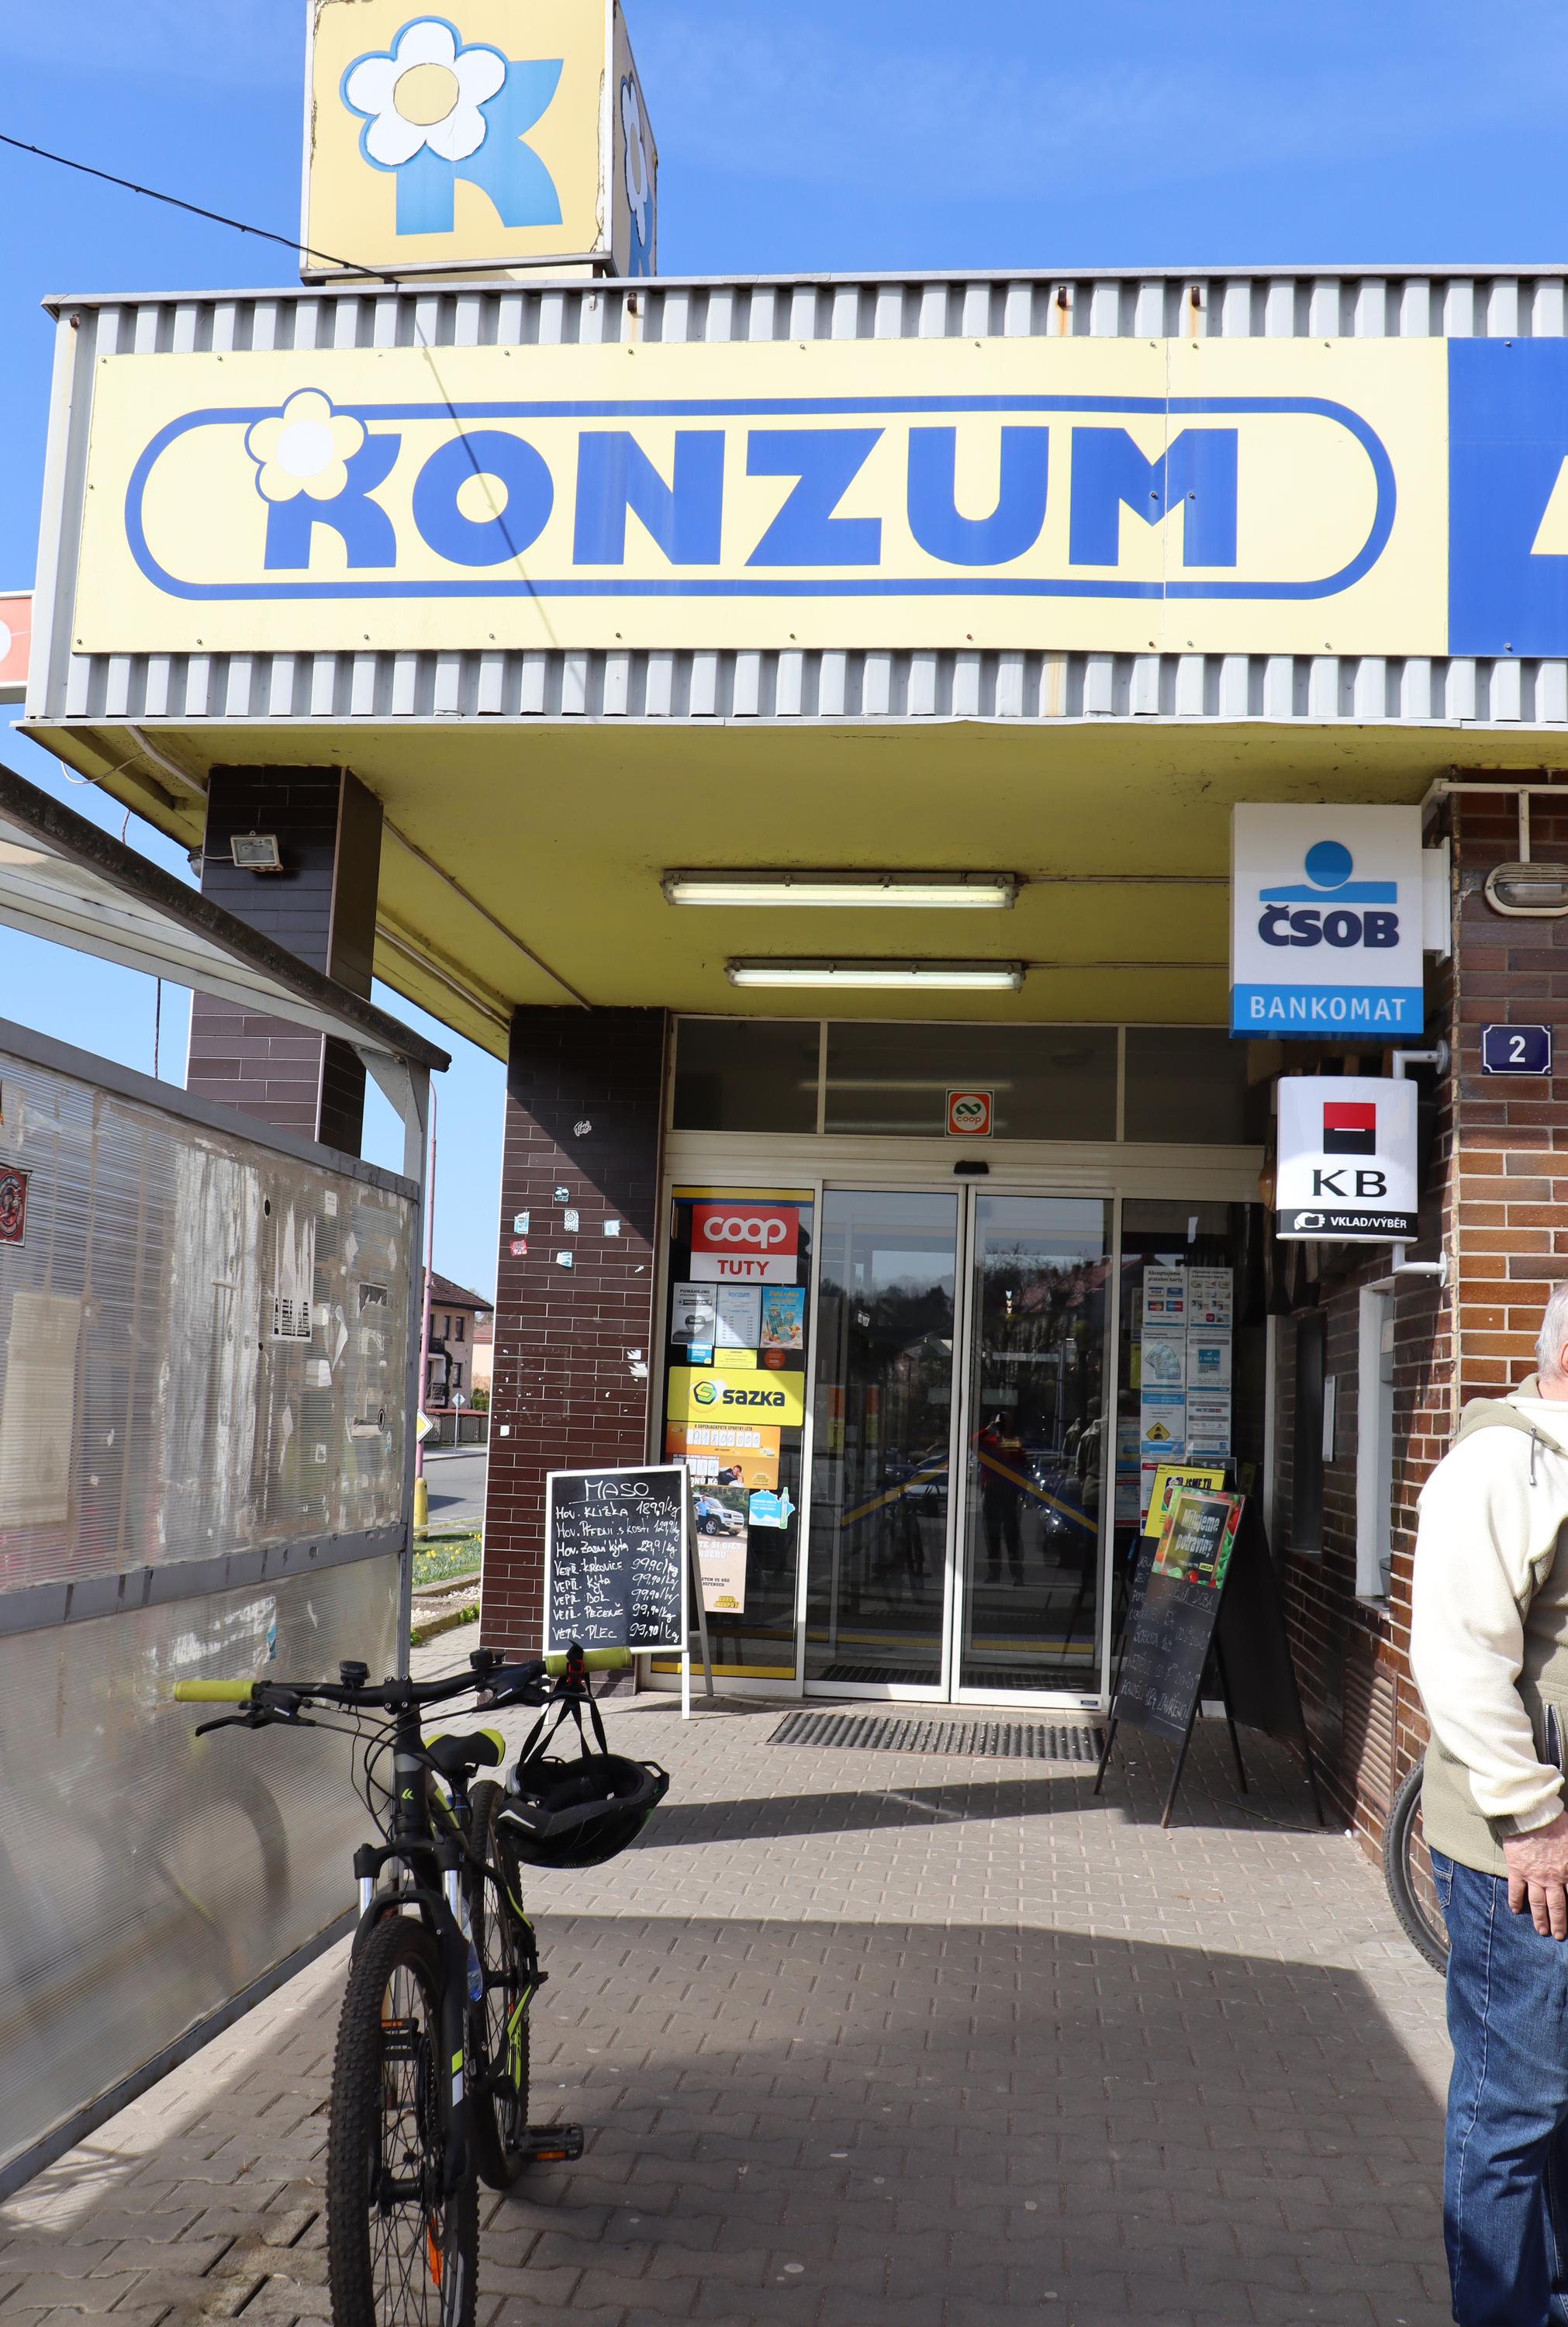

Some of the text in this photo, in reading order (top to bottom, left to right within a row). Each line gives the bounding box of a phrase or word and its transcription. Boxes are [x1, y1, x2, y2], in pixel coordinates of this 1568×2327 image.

[245, 387, 1238, 570] KONZUM
[1258, 904, 1400, 948] ČSOB
[1250, 995, 1407, 1021] BANKOMAT
[1509, 1036, 1526, 1063] 2
[1312, 1170, 1387, 1198] KB
[1331, 1215, 1407, 1229] VKLAD/VÝBĚR
[717, 1260, 770, 1276] TUTY
[722, 1389, 786, 1407] sazka
[585, 1479, 649, 1501] MASO
[1180, 1509, 1221, 1533] Milujeme
